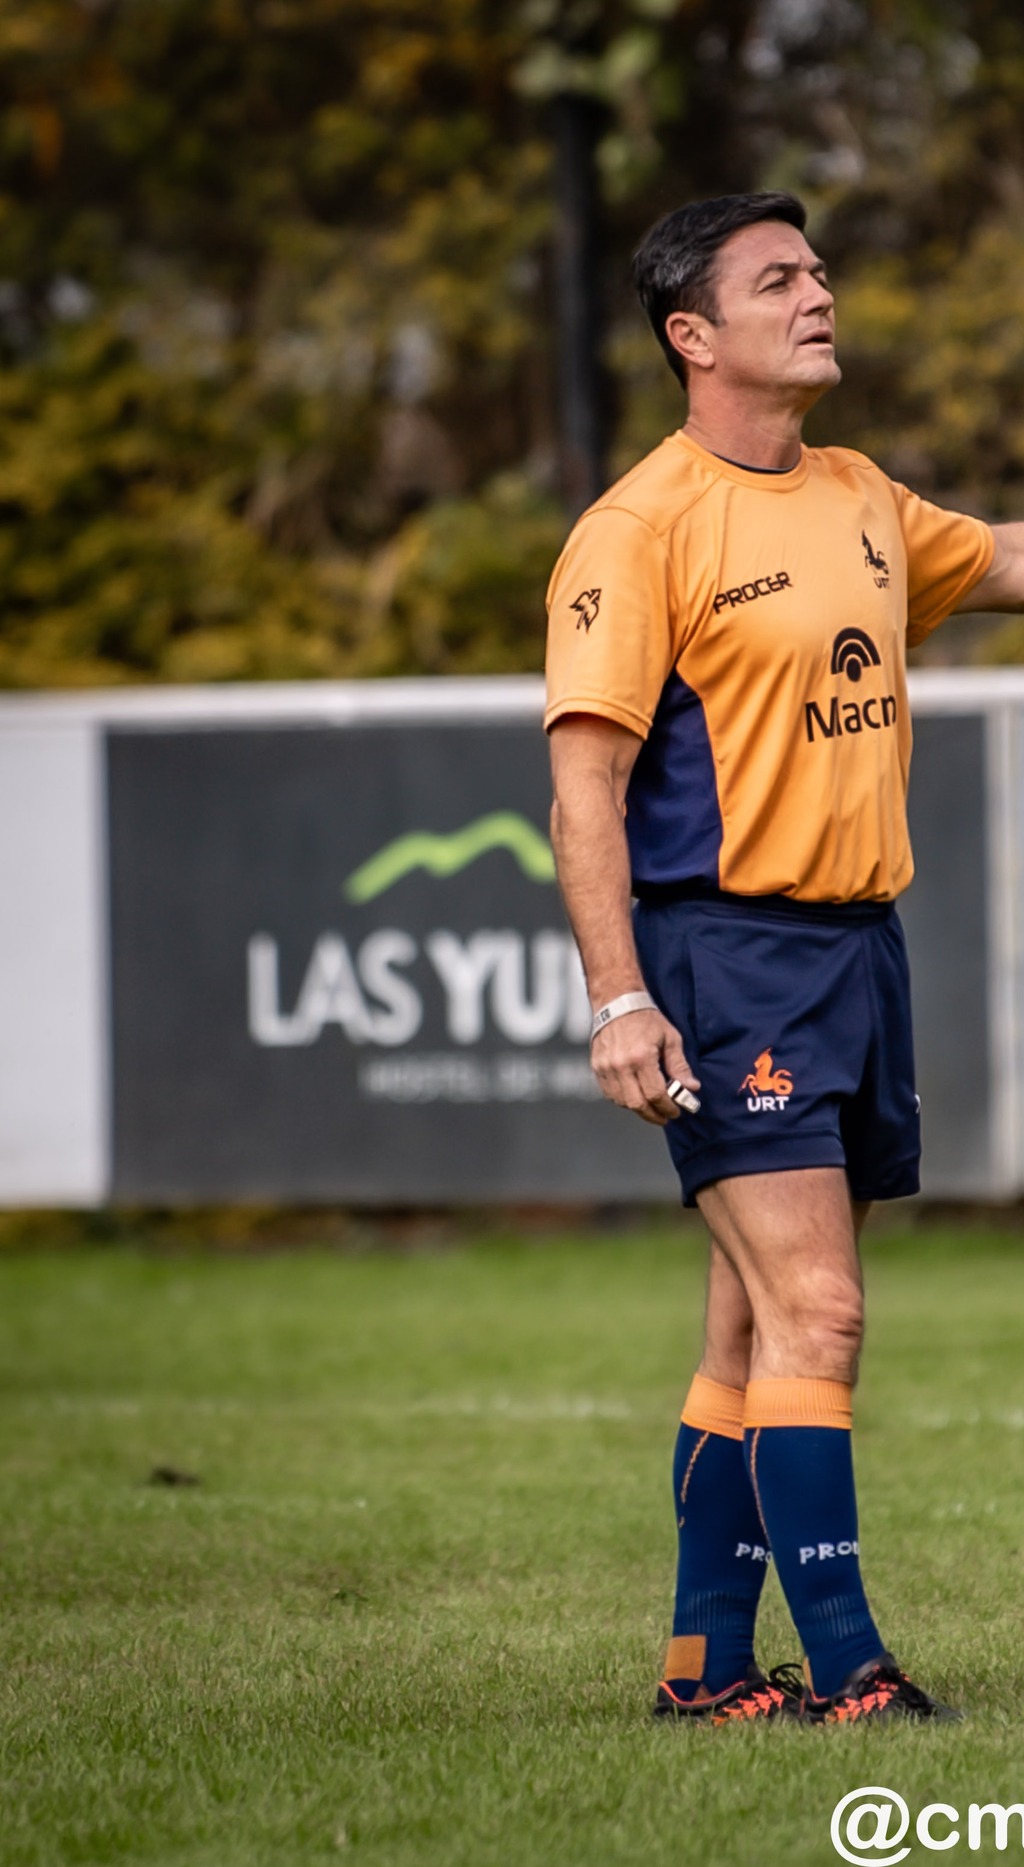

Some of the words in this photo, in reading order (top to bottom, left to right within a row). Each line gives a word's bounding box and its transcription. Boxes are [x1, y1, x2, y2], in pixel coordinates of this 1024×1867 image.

[713, 572, 793, 614] PROCER
[247, 930, 424, 1048] LAS
[747, 1096, 790, 1112] URT
